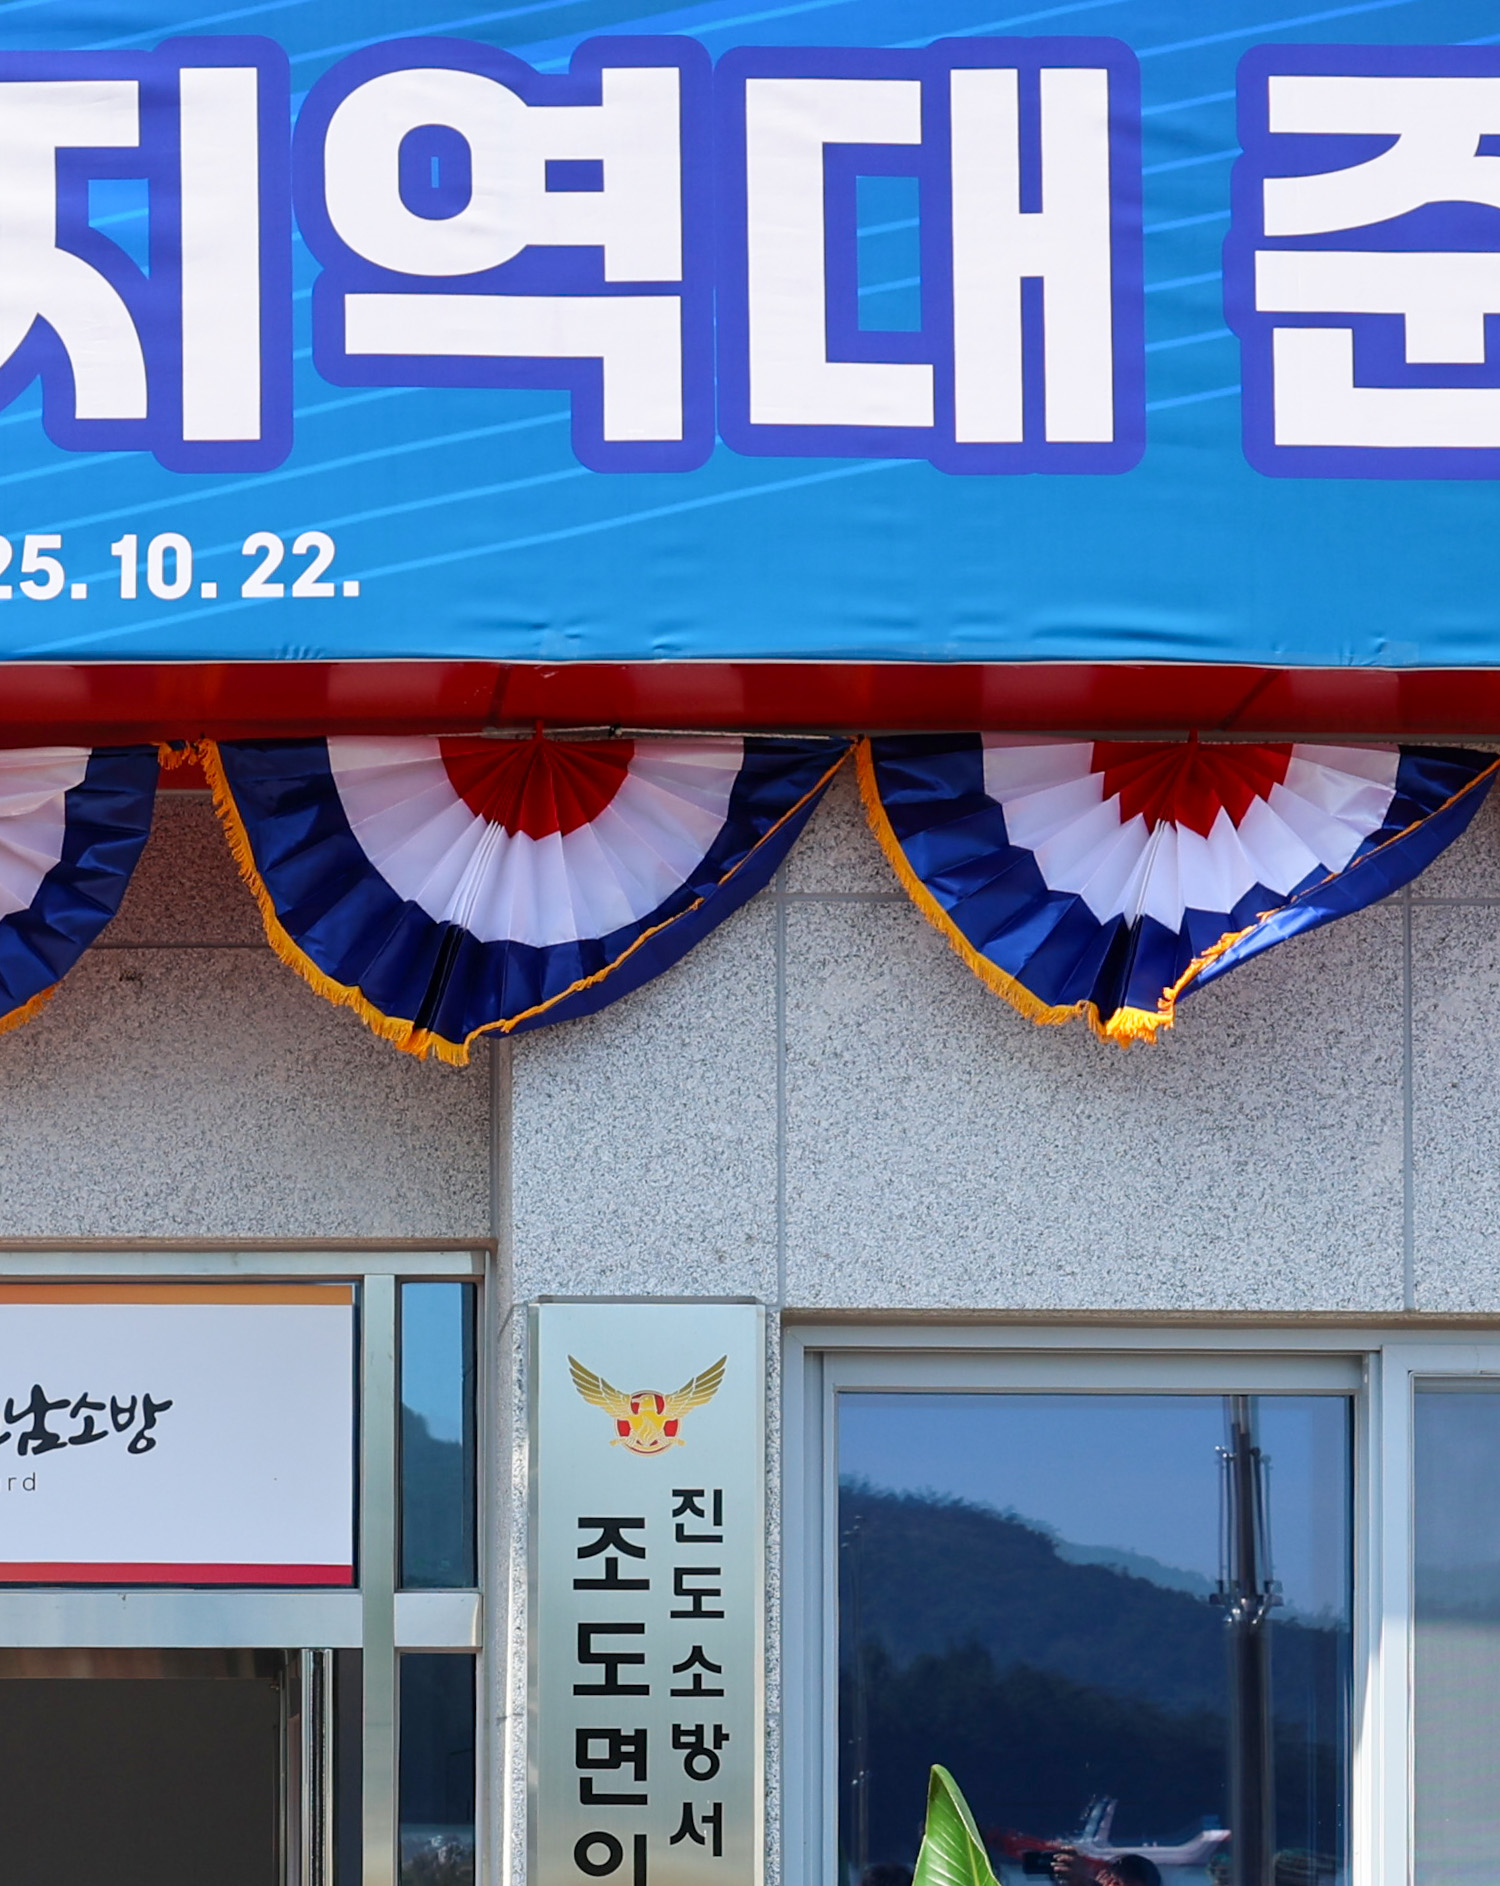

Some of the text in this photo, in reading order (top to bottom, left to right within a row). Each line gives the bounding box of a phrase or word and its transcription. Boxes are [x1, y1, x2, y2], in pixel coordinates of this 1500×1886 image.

[111, 533, 217, 600] 10.
[241, 532, 359, 599] 22.
[669, 1488, 730, 1857] 진도소방서
